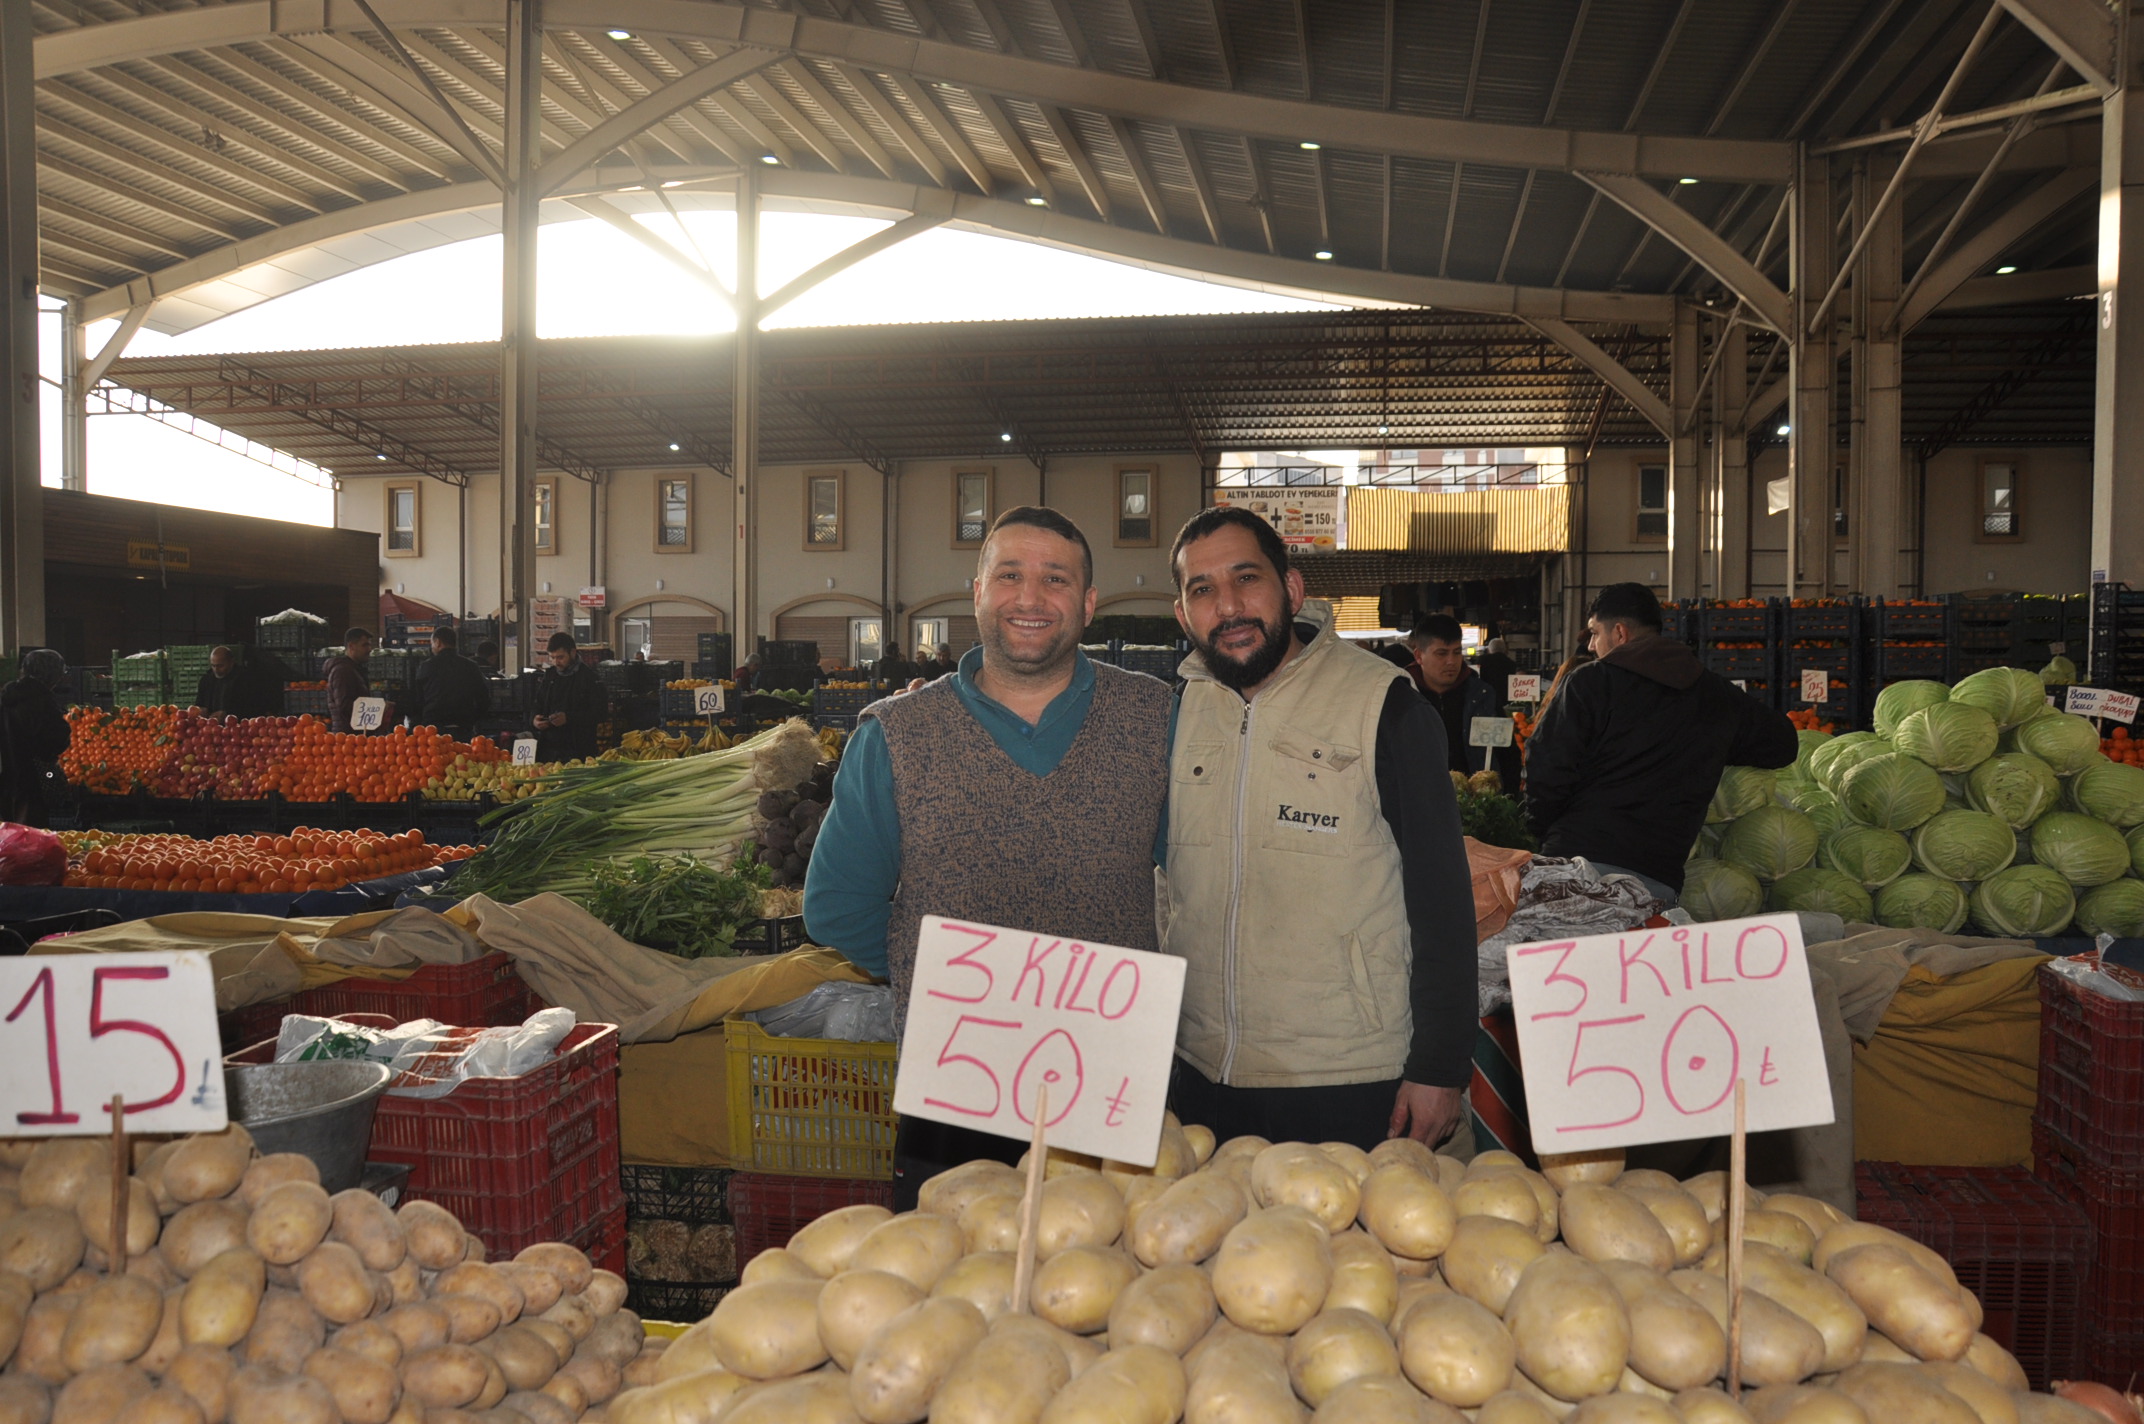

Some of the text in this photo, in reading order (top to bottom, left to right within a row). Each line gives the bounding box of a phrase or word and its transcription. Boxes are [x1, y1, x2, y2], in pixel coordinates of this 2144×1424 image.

[2102, 290, 2112, 329] 3
[1227, 490, 1248, 499] ALTIN
[1251, 490, 1285, 499] TABLDOT
[1287, 490, 1296, 499] EV
[1315, 513, 1331, 525] 150
[358, 702, 365, 713] 3
[700, 692, 717, 711] 60
[1807, 682, 1824, 700] 25
[1277, 804, 1340, 832] Karyer
[927, 923, 997, 1003] 3
[1517, 941, 1588, 1021] 3
[5, 966, 186, 1125] 15
[924, 1014, 1084, 1128] 50
[1556, 1005, 1739, 1133] 50
